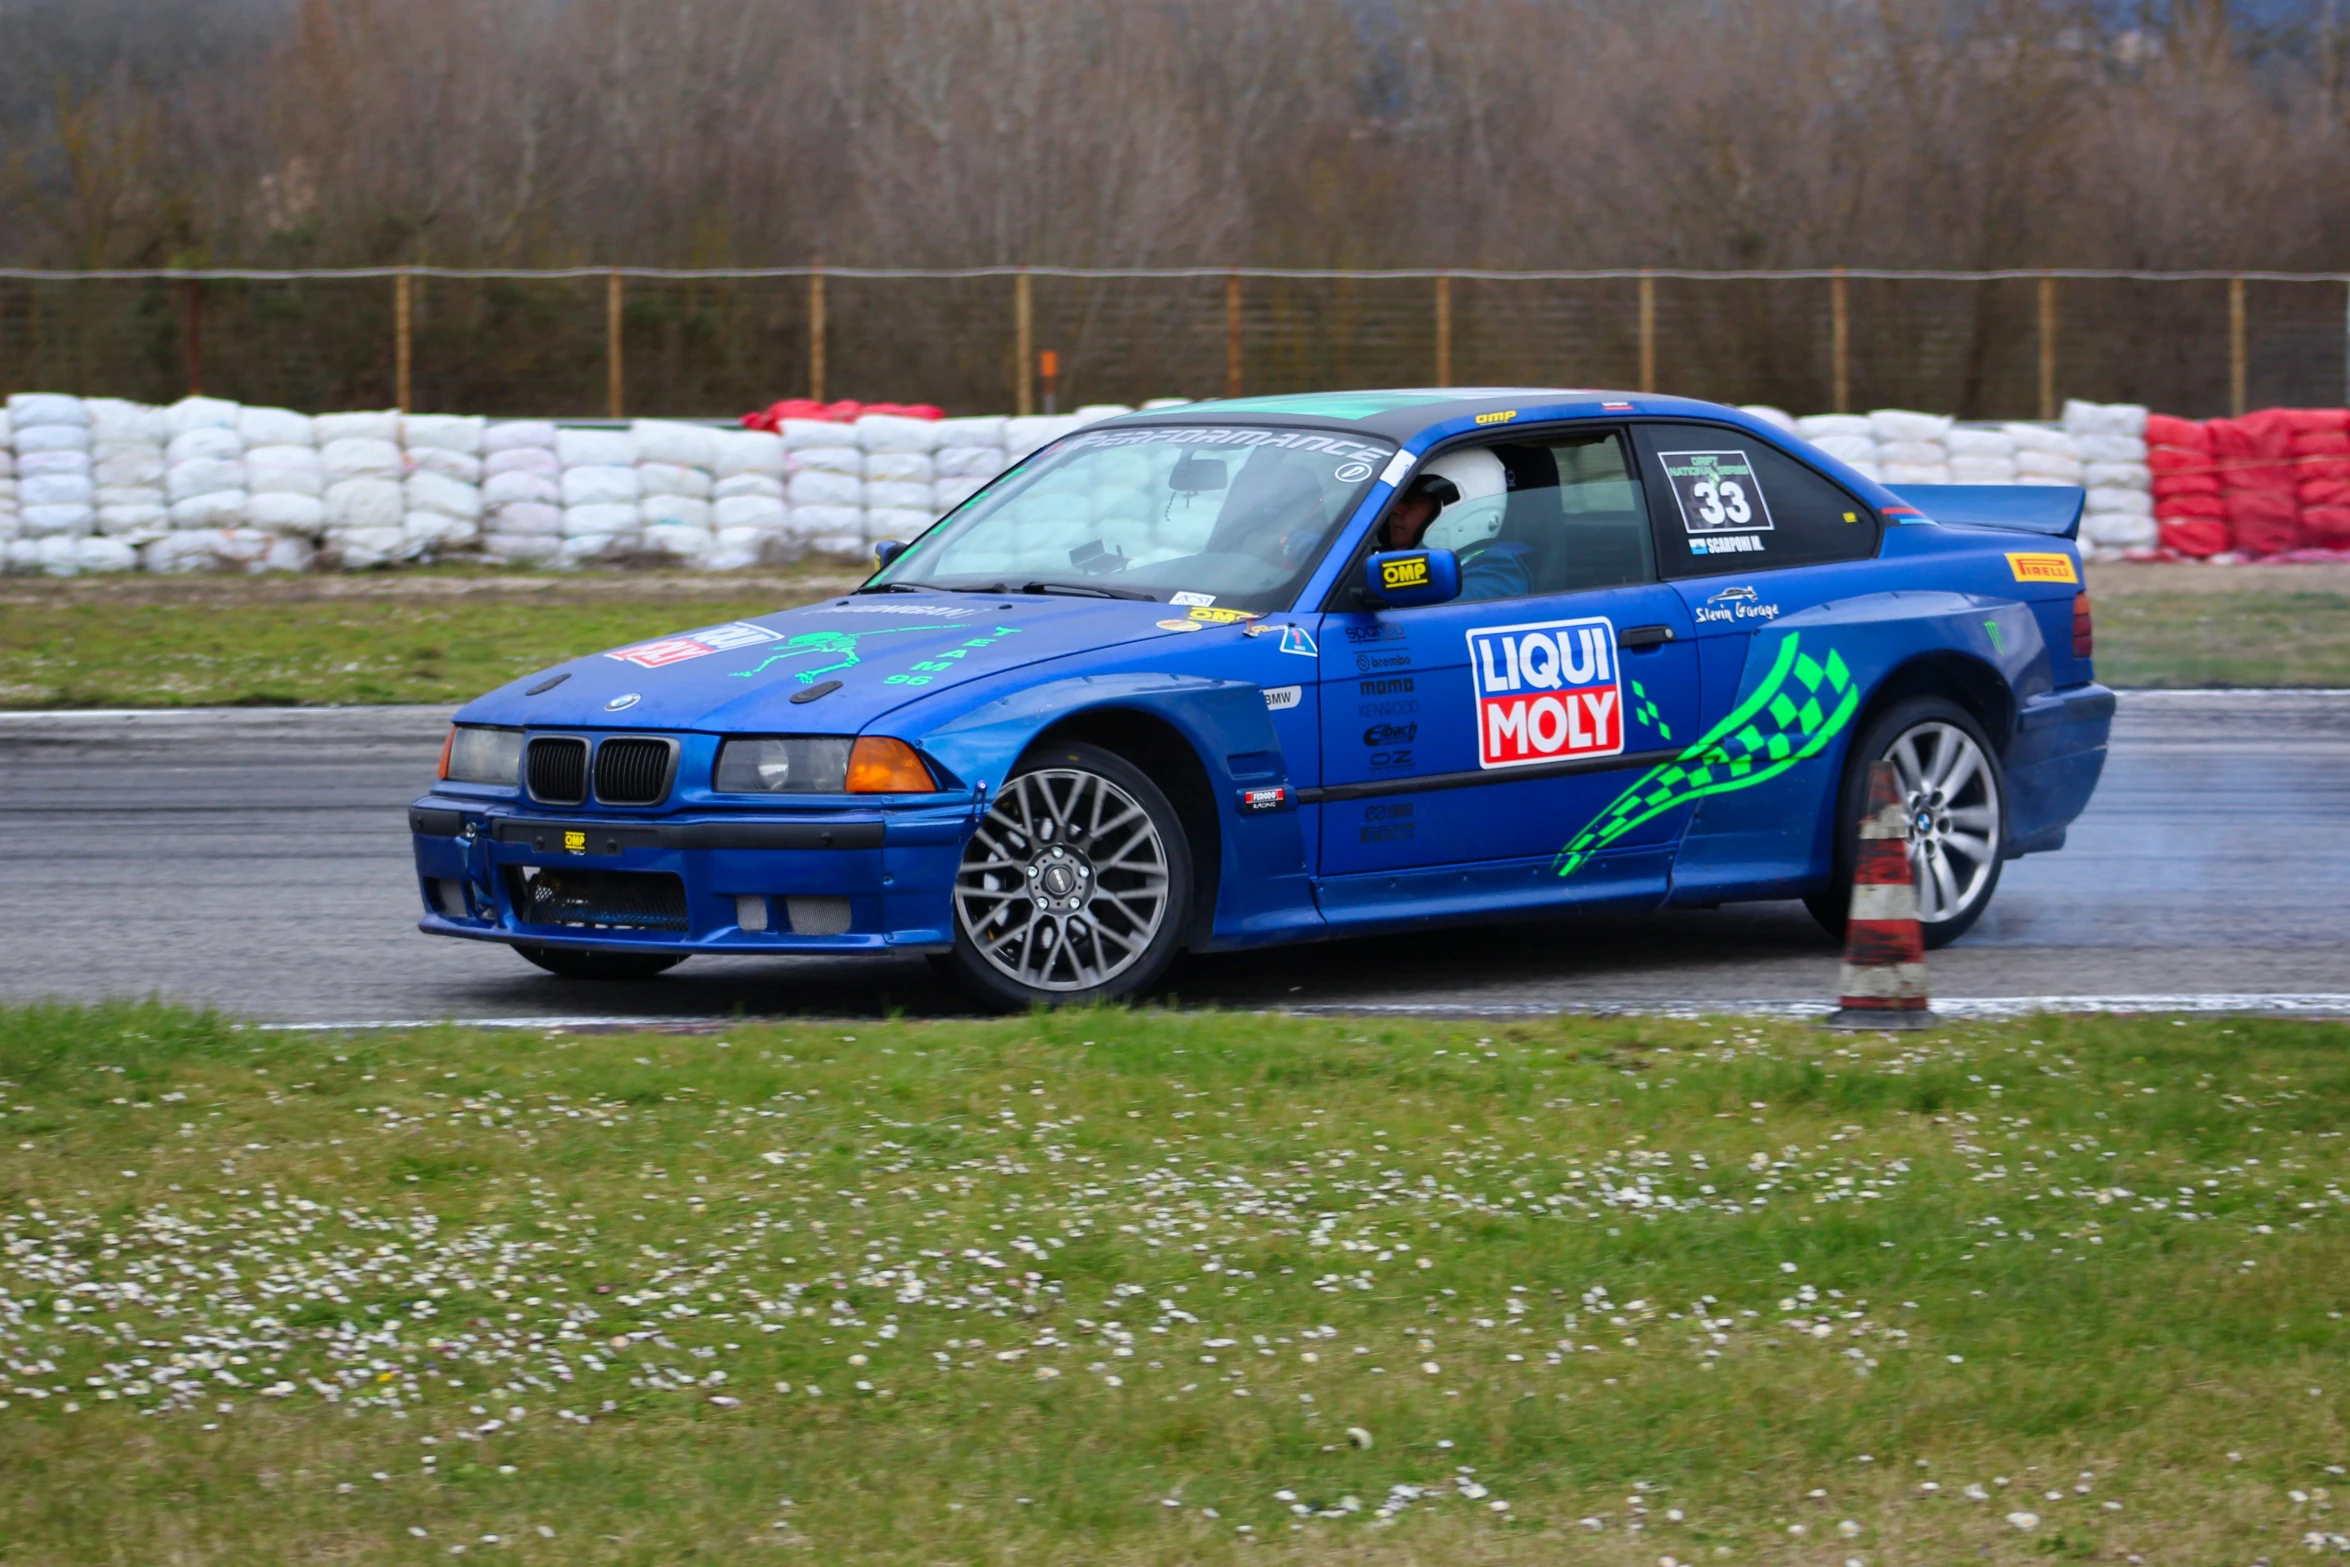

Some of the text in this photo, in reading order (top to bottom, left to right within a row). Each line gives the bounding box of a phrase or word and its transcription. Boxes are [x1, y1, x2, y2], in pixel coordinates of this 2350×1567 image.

[1694, 481, 1752, 525] 33
[1706, 536, 1752, 554] SCARPONI
[1383, 562, 1427, 584] OMP
[2016, 558, 2070, 578] PIRELLI
[1735, 602, 1780, 620] Garage
[1345, 623, 1405, 645] sparco
[1371, 655, 1412, 668] brembo
[1478, 627, 1610, 692] LIQUI
[883, 674, 934, 687] 96
[1265, 691, 1292, 706] BMW
[1358, 699, 1420, 718] KENWOOD
[1363, 720, 1419, 746] Eibach
[1487, 691, 1617, 758] MOLY
[564, 835, 586, 846] OMP
